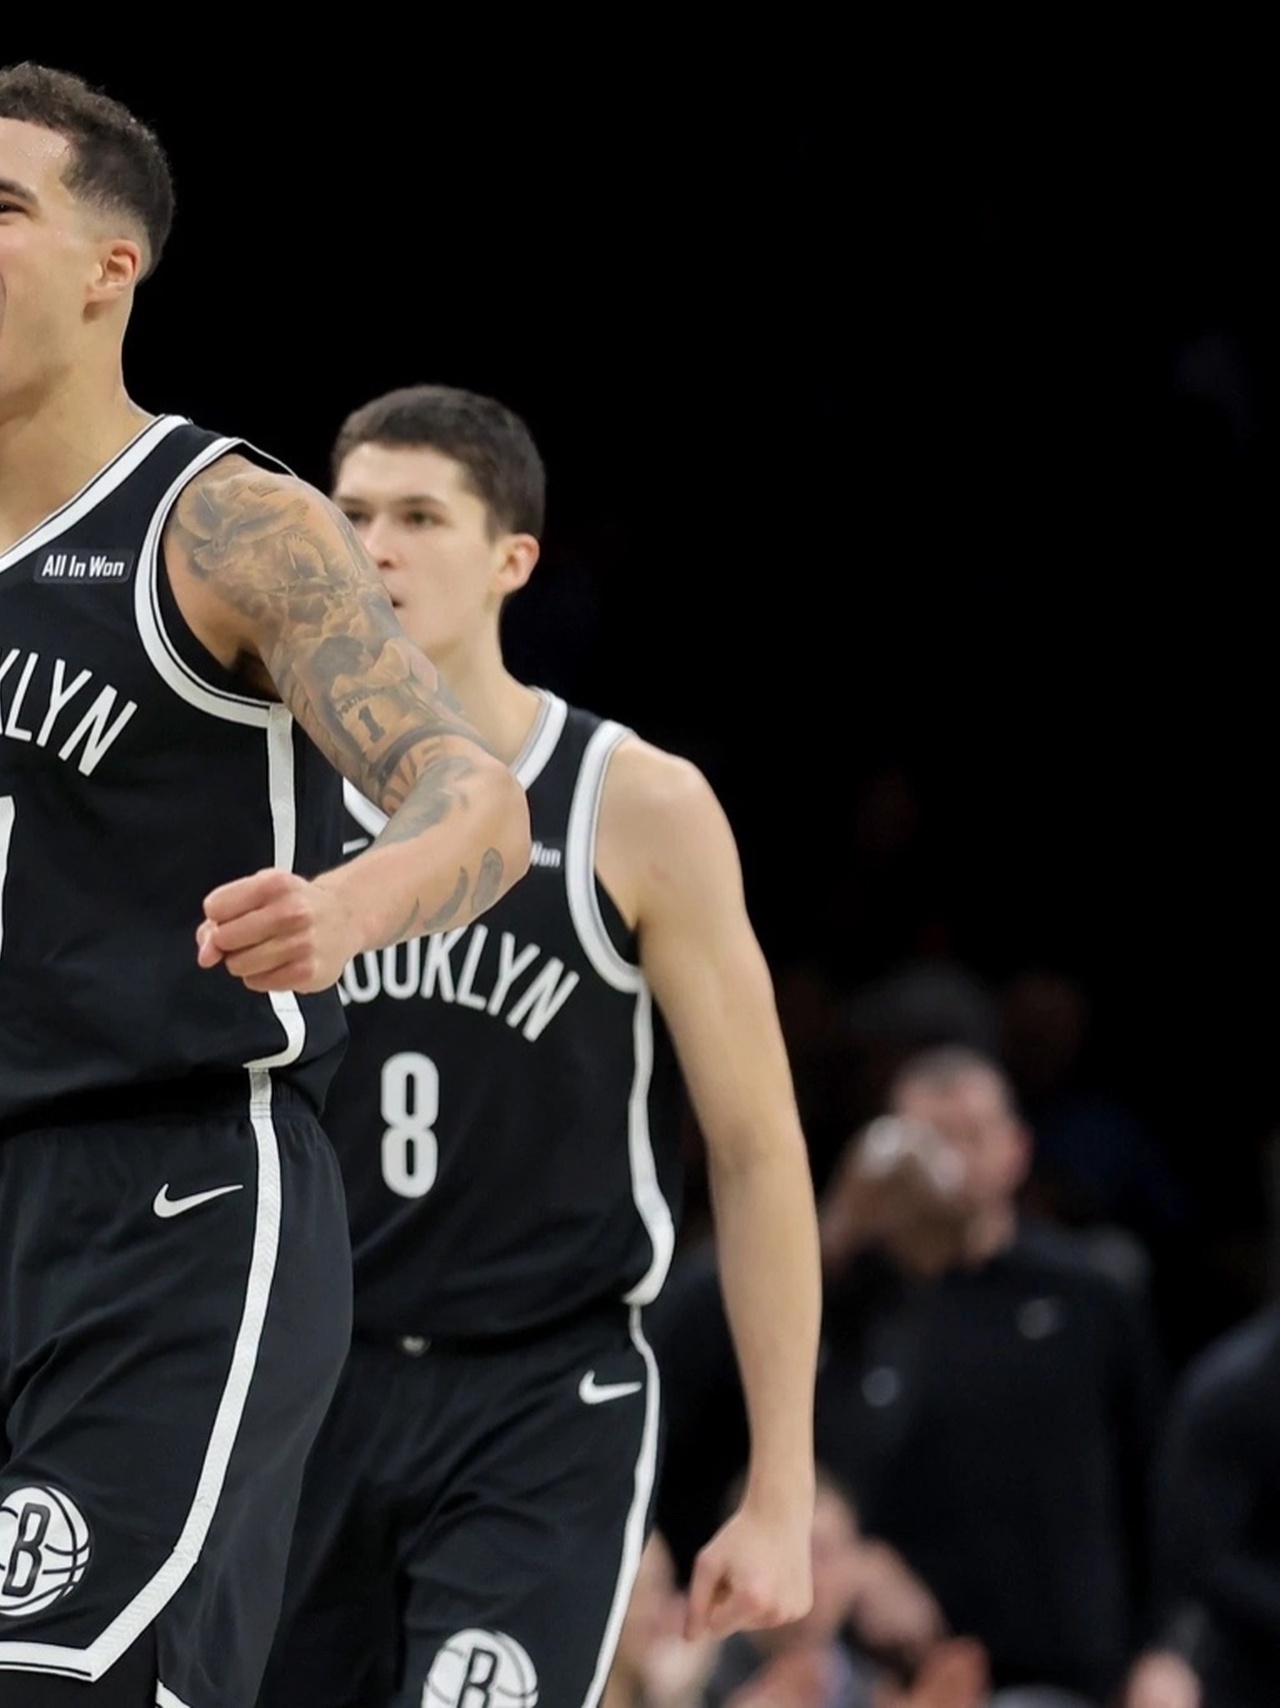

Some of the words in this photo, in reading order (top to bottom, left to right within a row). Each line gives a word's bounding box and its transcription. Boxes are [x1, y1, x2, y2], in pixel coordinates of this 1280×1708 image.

[41, 554, 67, 577] All
[68, 554, 87, 577] In
[89, 555, 125, 578] Won
[337, 923, 580, 1043] OOKLYN
[380, 1051, 440, 1199] 8
[1, 1502, 51, 1598] B
